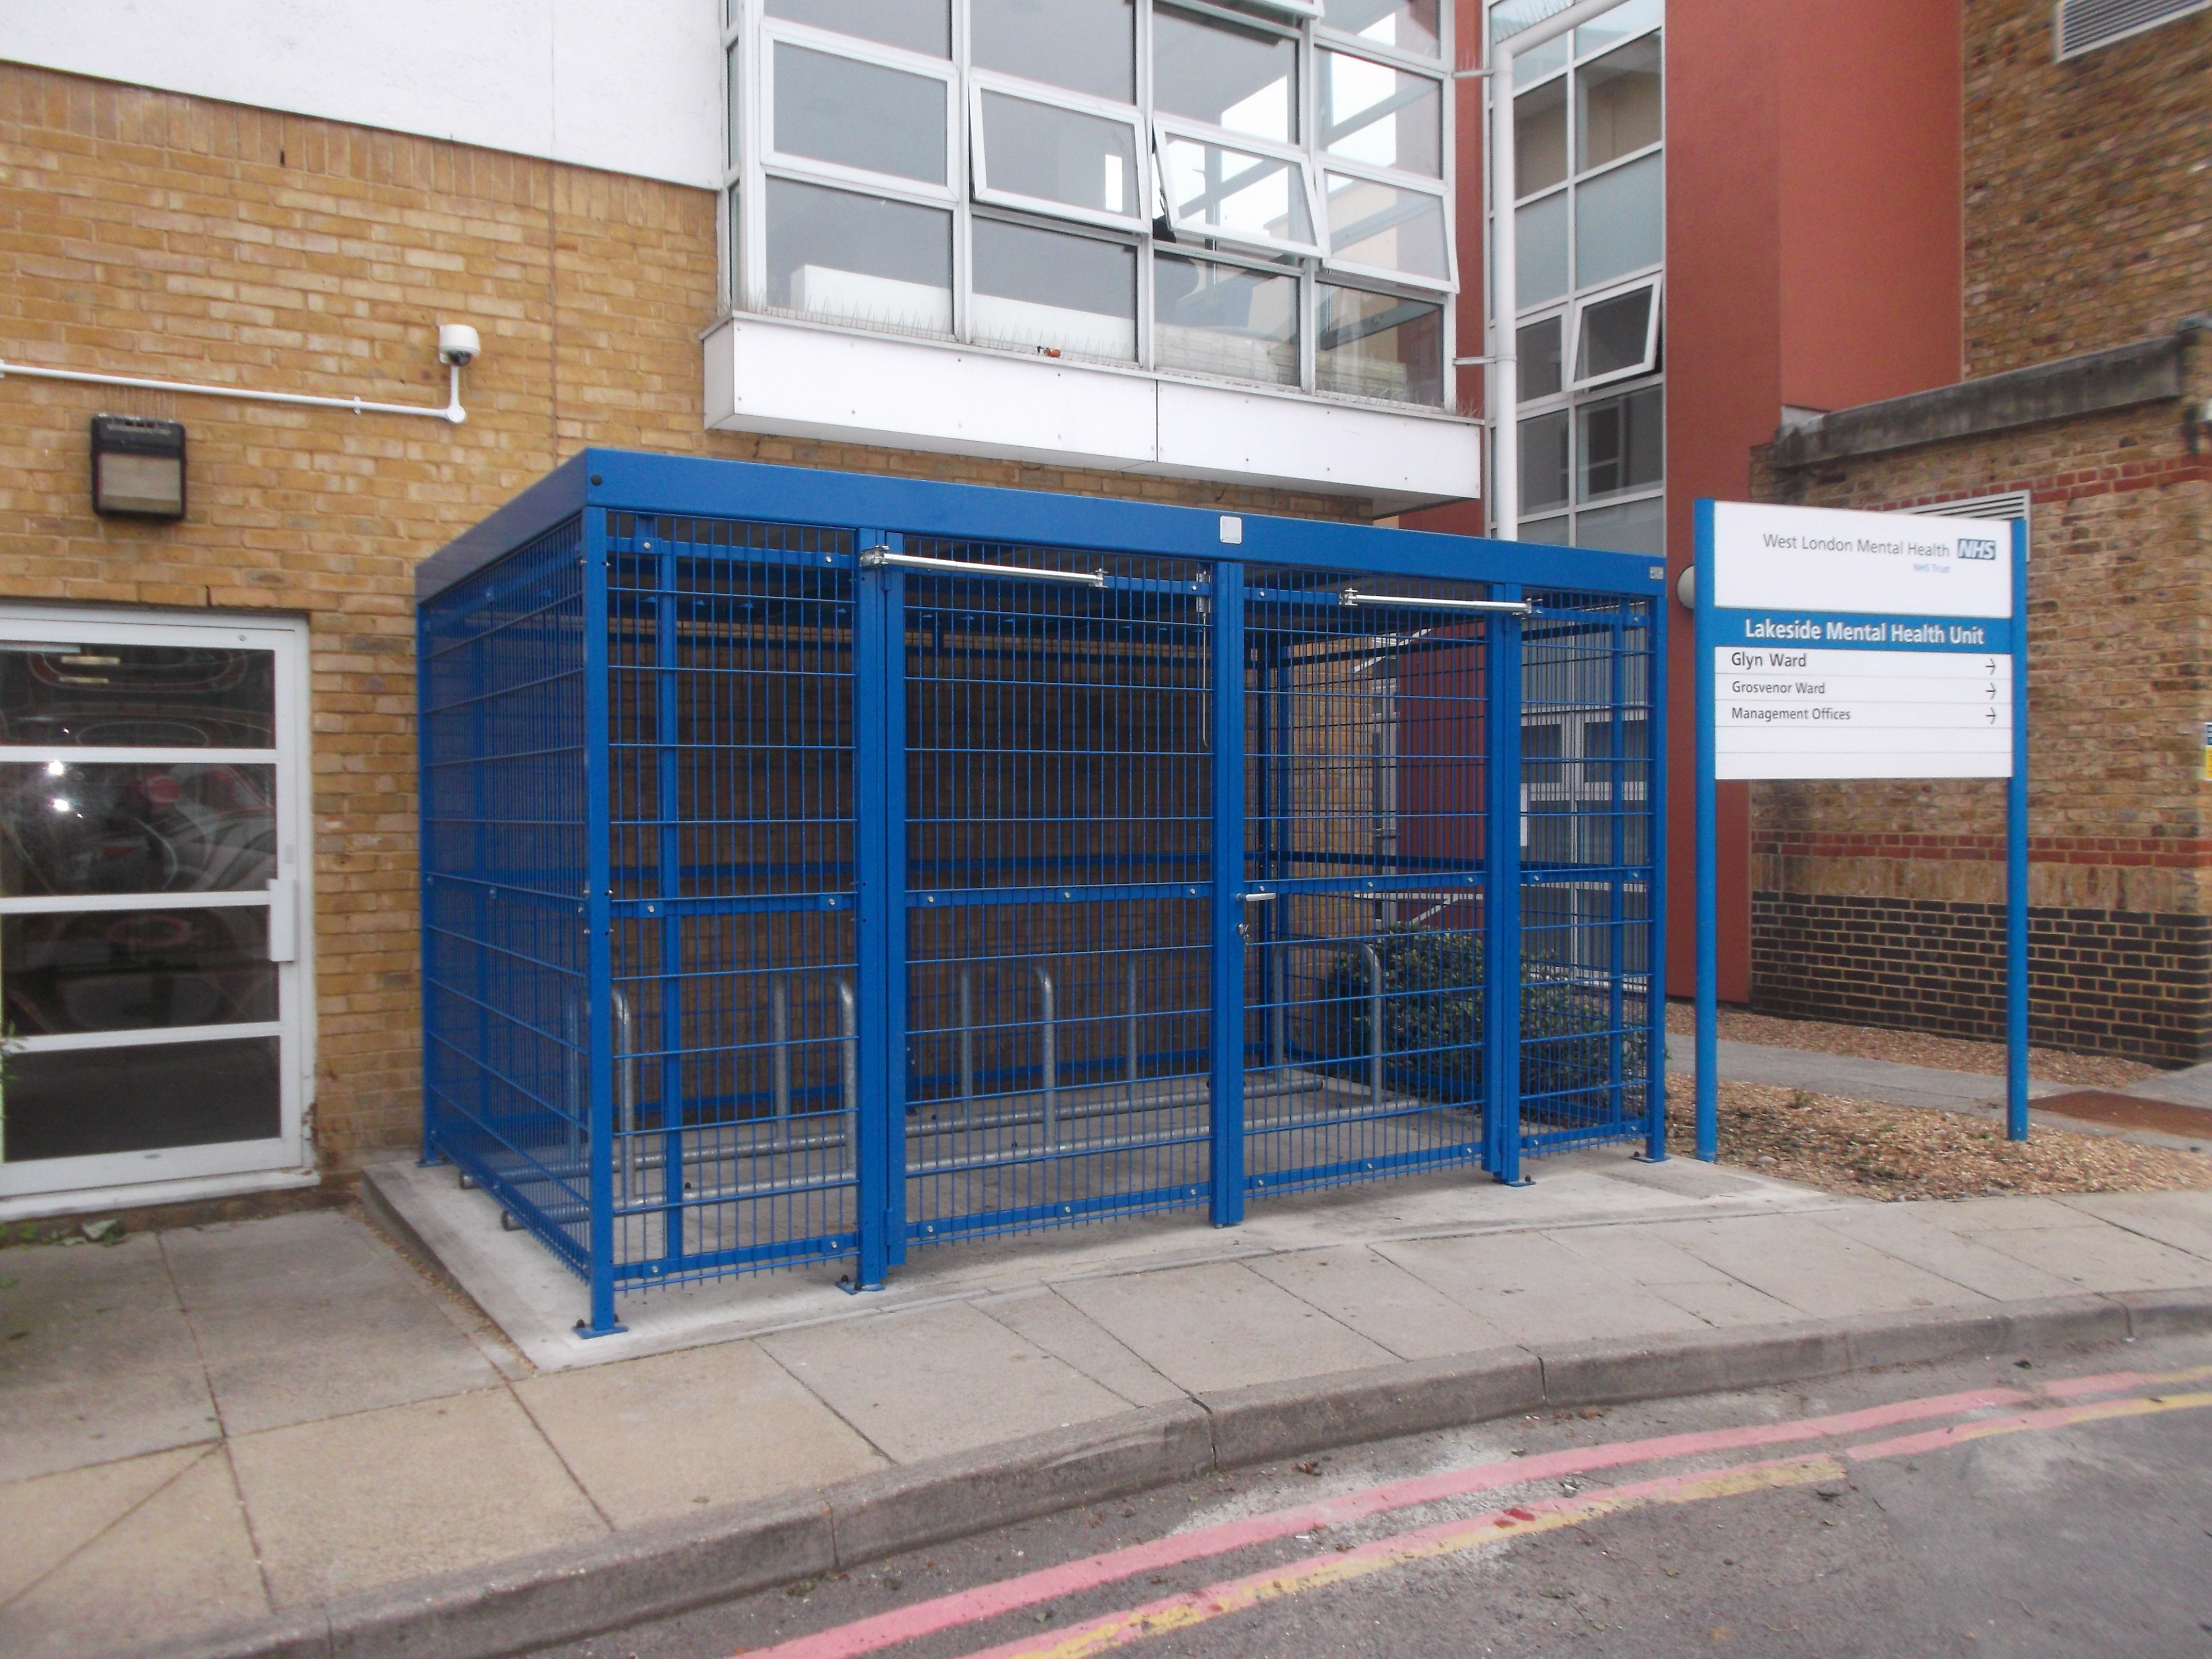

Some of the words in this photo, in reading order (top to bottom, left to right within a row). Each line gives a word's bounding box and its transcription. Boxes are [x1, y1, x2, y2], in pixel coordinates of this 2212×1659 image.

[1763, 534, 1797, 548] West
[1802, 536, 1852, 551] London
[1857, 539, 1903, 555] Mental
[1908, 541, 1950, 557] Health
[1958, 539, 1996, 560] NHS
[1913, 563, 1930, 572] NHS
[1932, 564, 1950, 573] Trust
[1746, 618, 1821, 639] Lakeside
[1826, 621, 1886, 641] Mental
[1891, 624, 1945, 643] Health
[1949, 626, 1985, 644] Unit
[1731, 652, 1763, 670] Glyn
[1769, 653, 1807, 668] Ward
[1732, 681, 1792, 694] Grosvenor
[1795, 681, 1825, 694] Ward
[1731, 707, 1809, 722] Management
[1812, 707, 1851, 720] Offices
